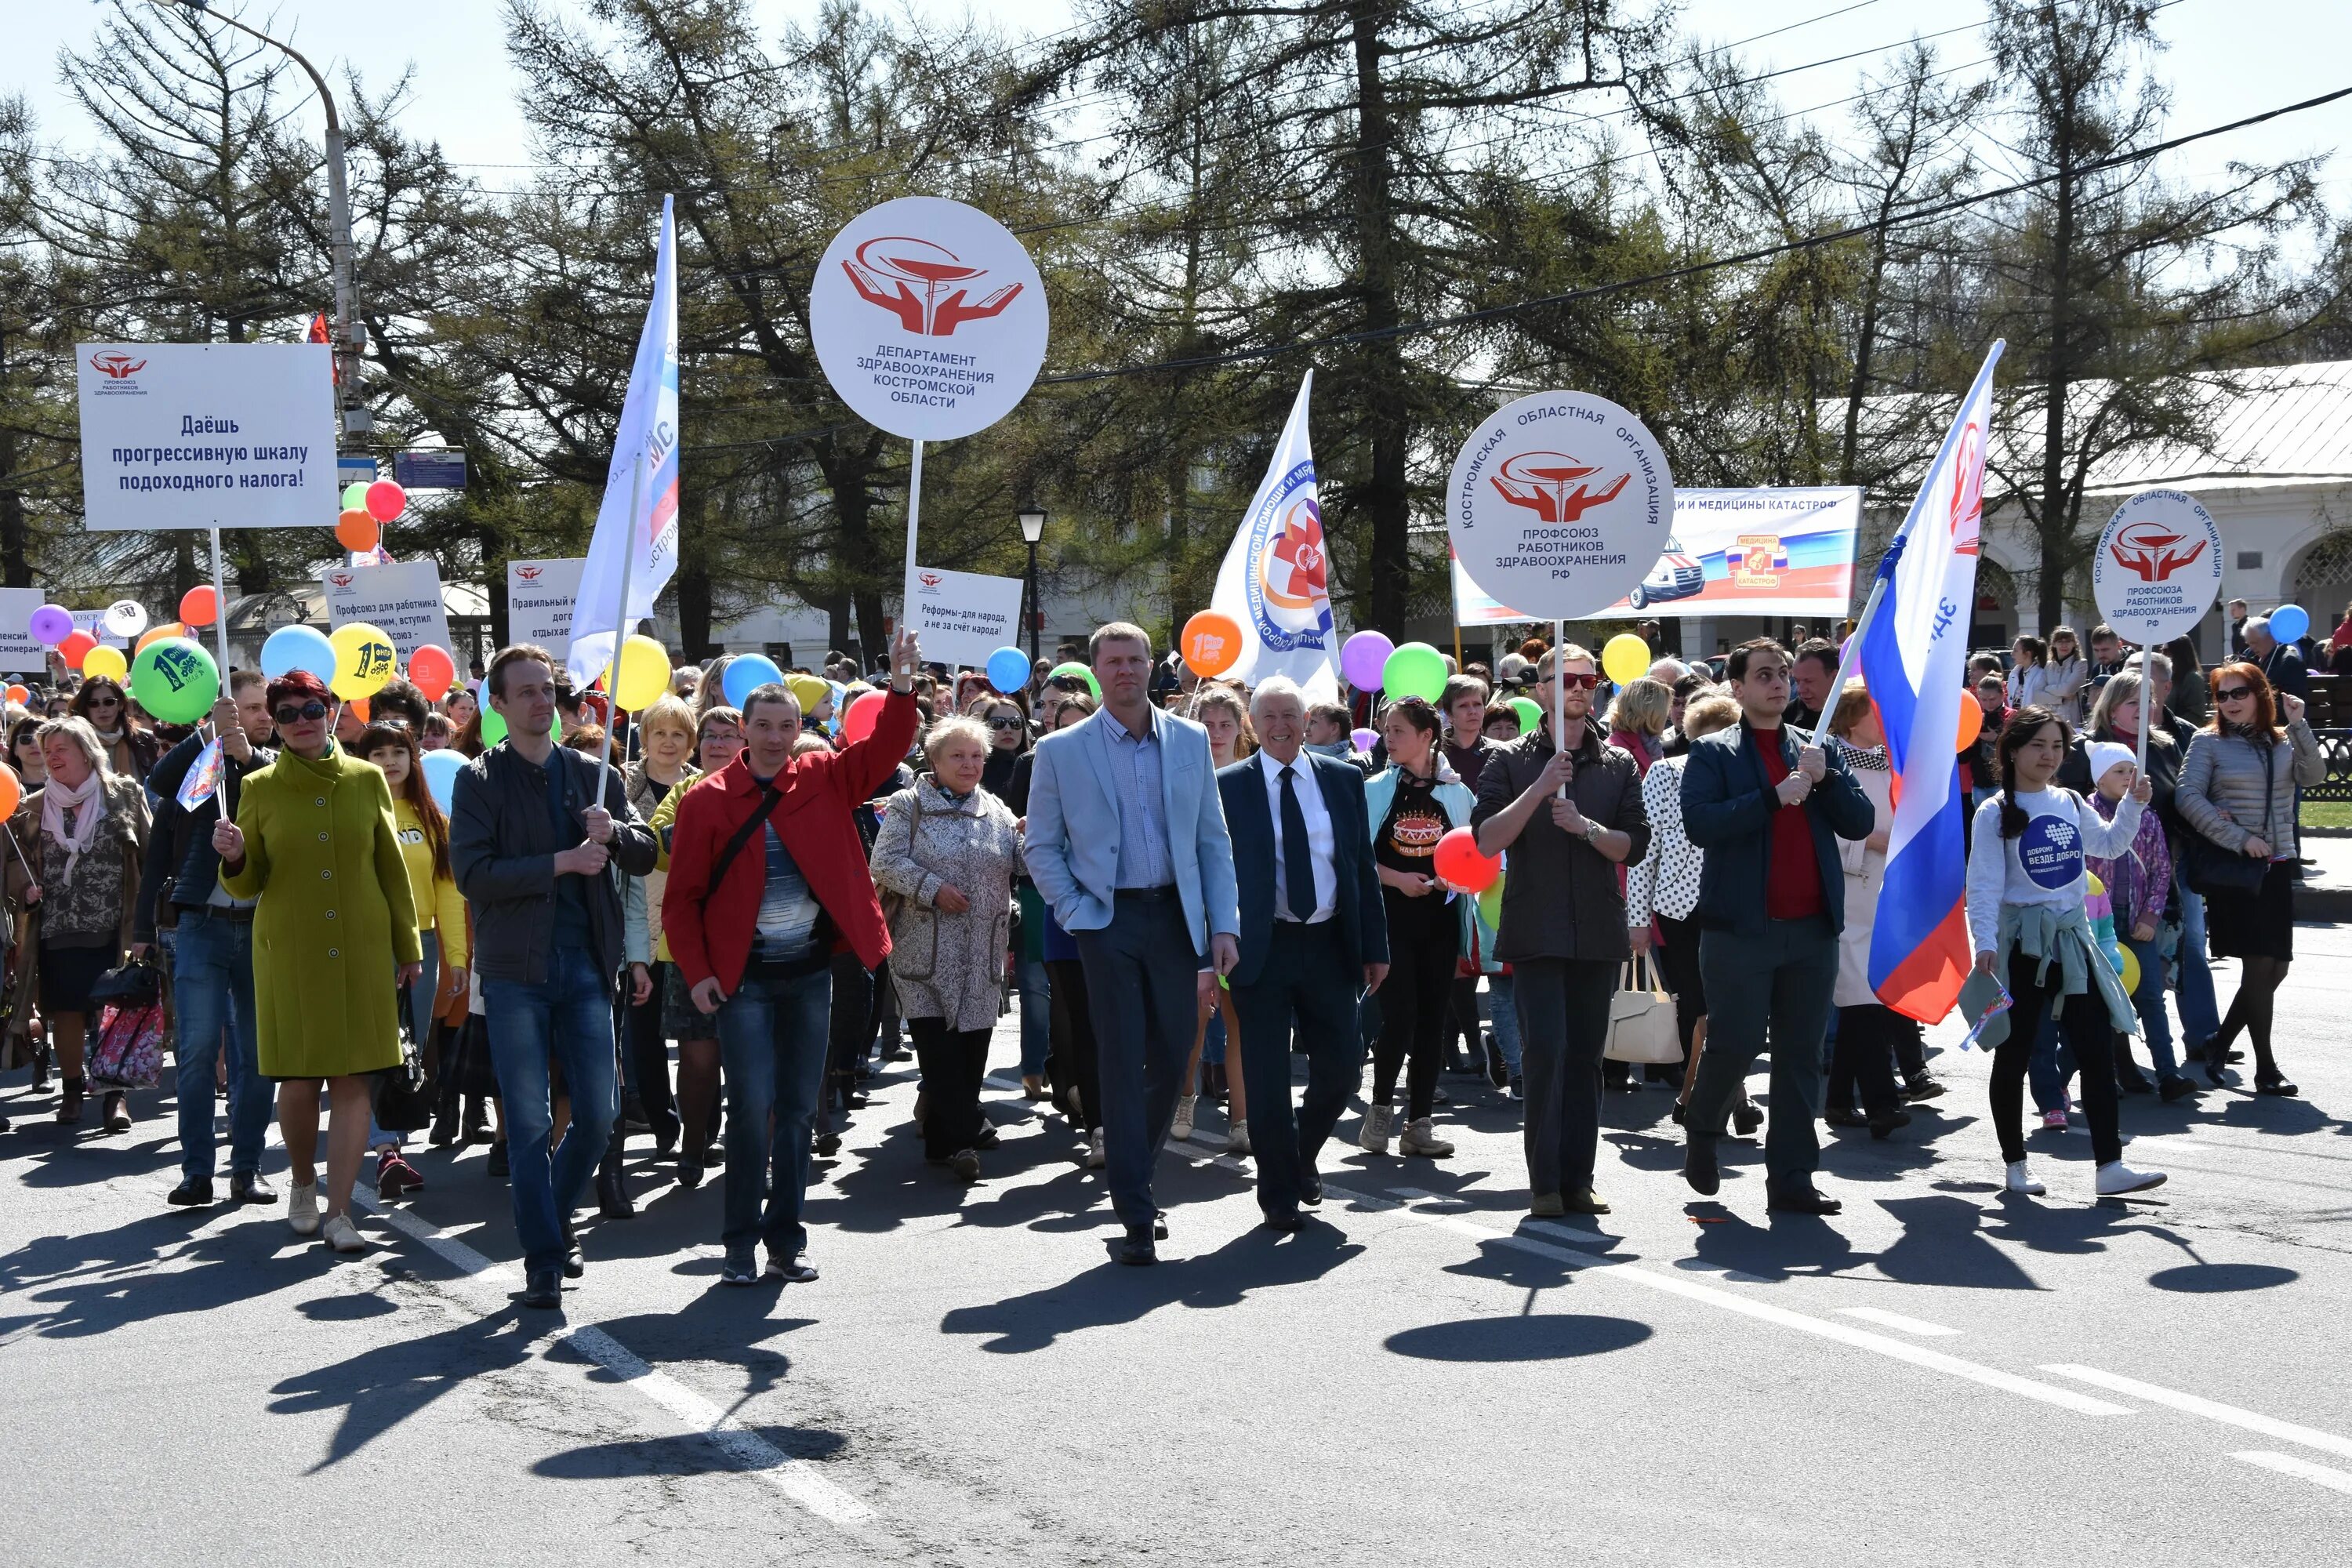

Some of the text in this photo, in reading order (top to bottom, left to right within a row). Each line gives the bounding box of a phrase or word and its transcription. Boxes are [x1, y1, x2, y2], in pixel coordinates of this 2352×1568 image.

[876, 344, 976, 367] ДЕПАРТАМЕНТ
[857, 357, 994, 383] ЗДРАВООХРАНЕНИЯ
[873, 374, 975, 396] КОСТРОМСКОЙ
[891, 391, 955, 408] ОБЛАСТИ
[181, 415, 239, 436] Даёшь
[112, 445, 308, 466] прогрессивную шкалу
[1462, 405, 1660, 529] КОСТРОМСКАЯ ОБЛАСТНАЯ ОРГАНИЗАЦИЯ
[119, 469, 303, 492] подоходного налога!
[1688, 501, 1695, 510] И
[1699, 500, 1765, 510] МЕДИЦИНЫ
[1769, 500, 1837, 510] КАТАСТРОФ
[1523, 528, 1599, 539] ПРОФСОЮЗ
[2095, 490, 2223, 584] КОСТРОМСКАЯ ОБЛАСТНАЯ ОРГАНИЗАЦИЯ
[1248, 534, 1264, 620] МЕДИЦИНСКОЙ
[1257, 483, 1288, 531] ПОМОЩИ
[1286, 476, 1296, 487] И
[1518, 541, 1604, 553] РАБОТНИКОВ
[1495, 554, 1626, 568] ЗДРАВООХРАНЕНИЯ
[1552, 569, 1570, 580] РФ
[2127, 586, 2183, 596] ПРОФСОЮЗА
[336, 599, 437, 617] Профсоюз для работника
[512, 596, 568, 610] Правильный
[2126, 596, 2183, 606] РАБОТНИКОВ
[552, 613, 573, 622] дого
[921, 603, 1007, 624] Реформы-для народа,
[2112, 606, 2197, 618] ЗДРАВООХРАНЕНИЯ
[399, 615, 432, 626] вступил
[953, 622, 971, 632] счёт
[971, 626, 1002, 636] народа!
[376, 648, 392, 657] ФНПР
[354, 641, 372, 679] 1
[153, 654, 185, 692] 1
[1416, 846, 1422, 857] 1
[2027, 846, 2053, 856] ДОБРОМУ
[2028, 854, 2055, 865] ВЕЗДЕ
